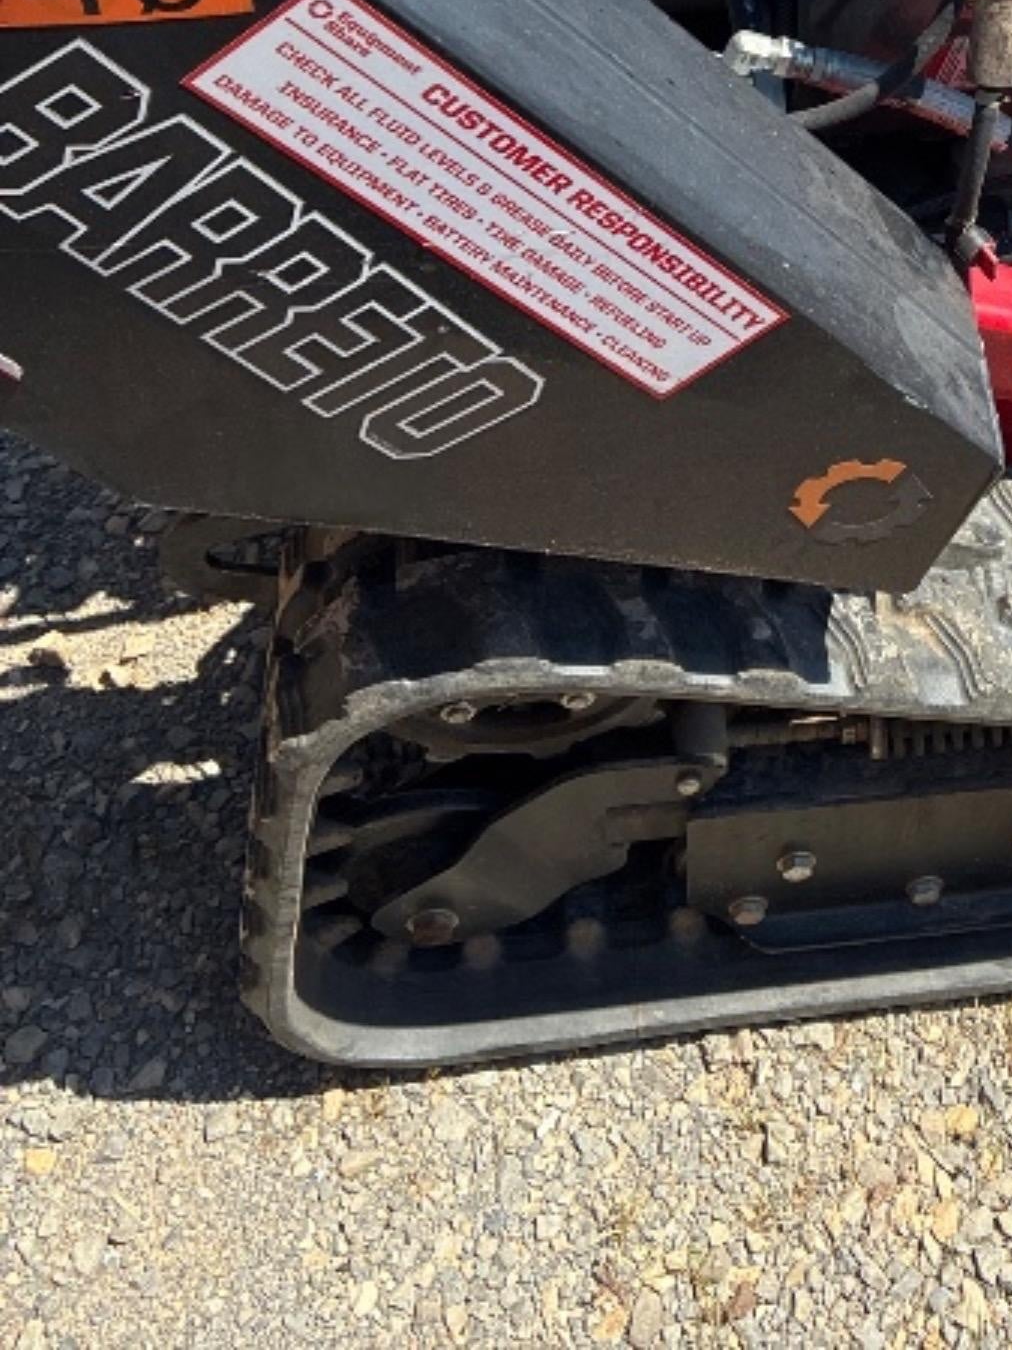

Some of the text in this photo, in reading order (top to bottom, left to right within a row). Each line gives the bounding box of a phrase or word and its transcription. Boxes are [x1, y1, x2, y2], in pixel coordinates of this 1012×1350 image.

[322, 19, 372, 58] Share
[336, 10, 422, 75] Equipment
[0, 37, 546, 462] BARRETO
[212, 74, 670, 382] DAMAGE TO EQUIPMENT BATTERY MAINTENANCE CLEANING
[274, 41, 340, 89] CHECK
[333, 85, 368, 112] ALL
[366, 106, 422, 146] FLUID
[418, 142, 480, 187] LEVELS
[489, 192, 553, 237] GREASE
[547, 233, 596, 267] DAILY
[590, 262, 650, 305] BEFORE
[644, 300, 693, 333] START
[686, 328, 712, 346] UP
[277, 80, 381, 153] INSURANCE
[385, 154, 431, 186] FLAT
[427, 181, 478, 220] TIRES
[519, 247, 586, 294] DAMAGE
[588, 294, 666, 349] REFUELING
[421, 83, 765, 329] CUSTOMER RESPONSIBILITY
